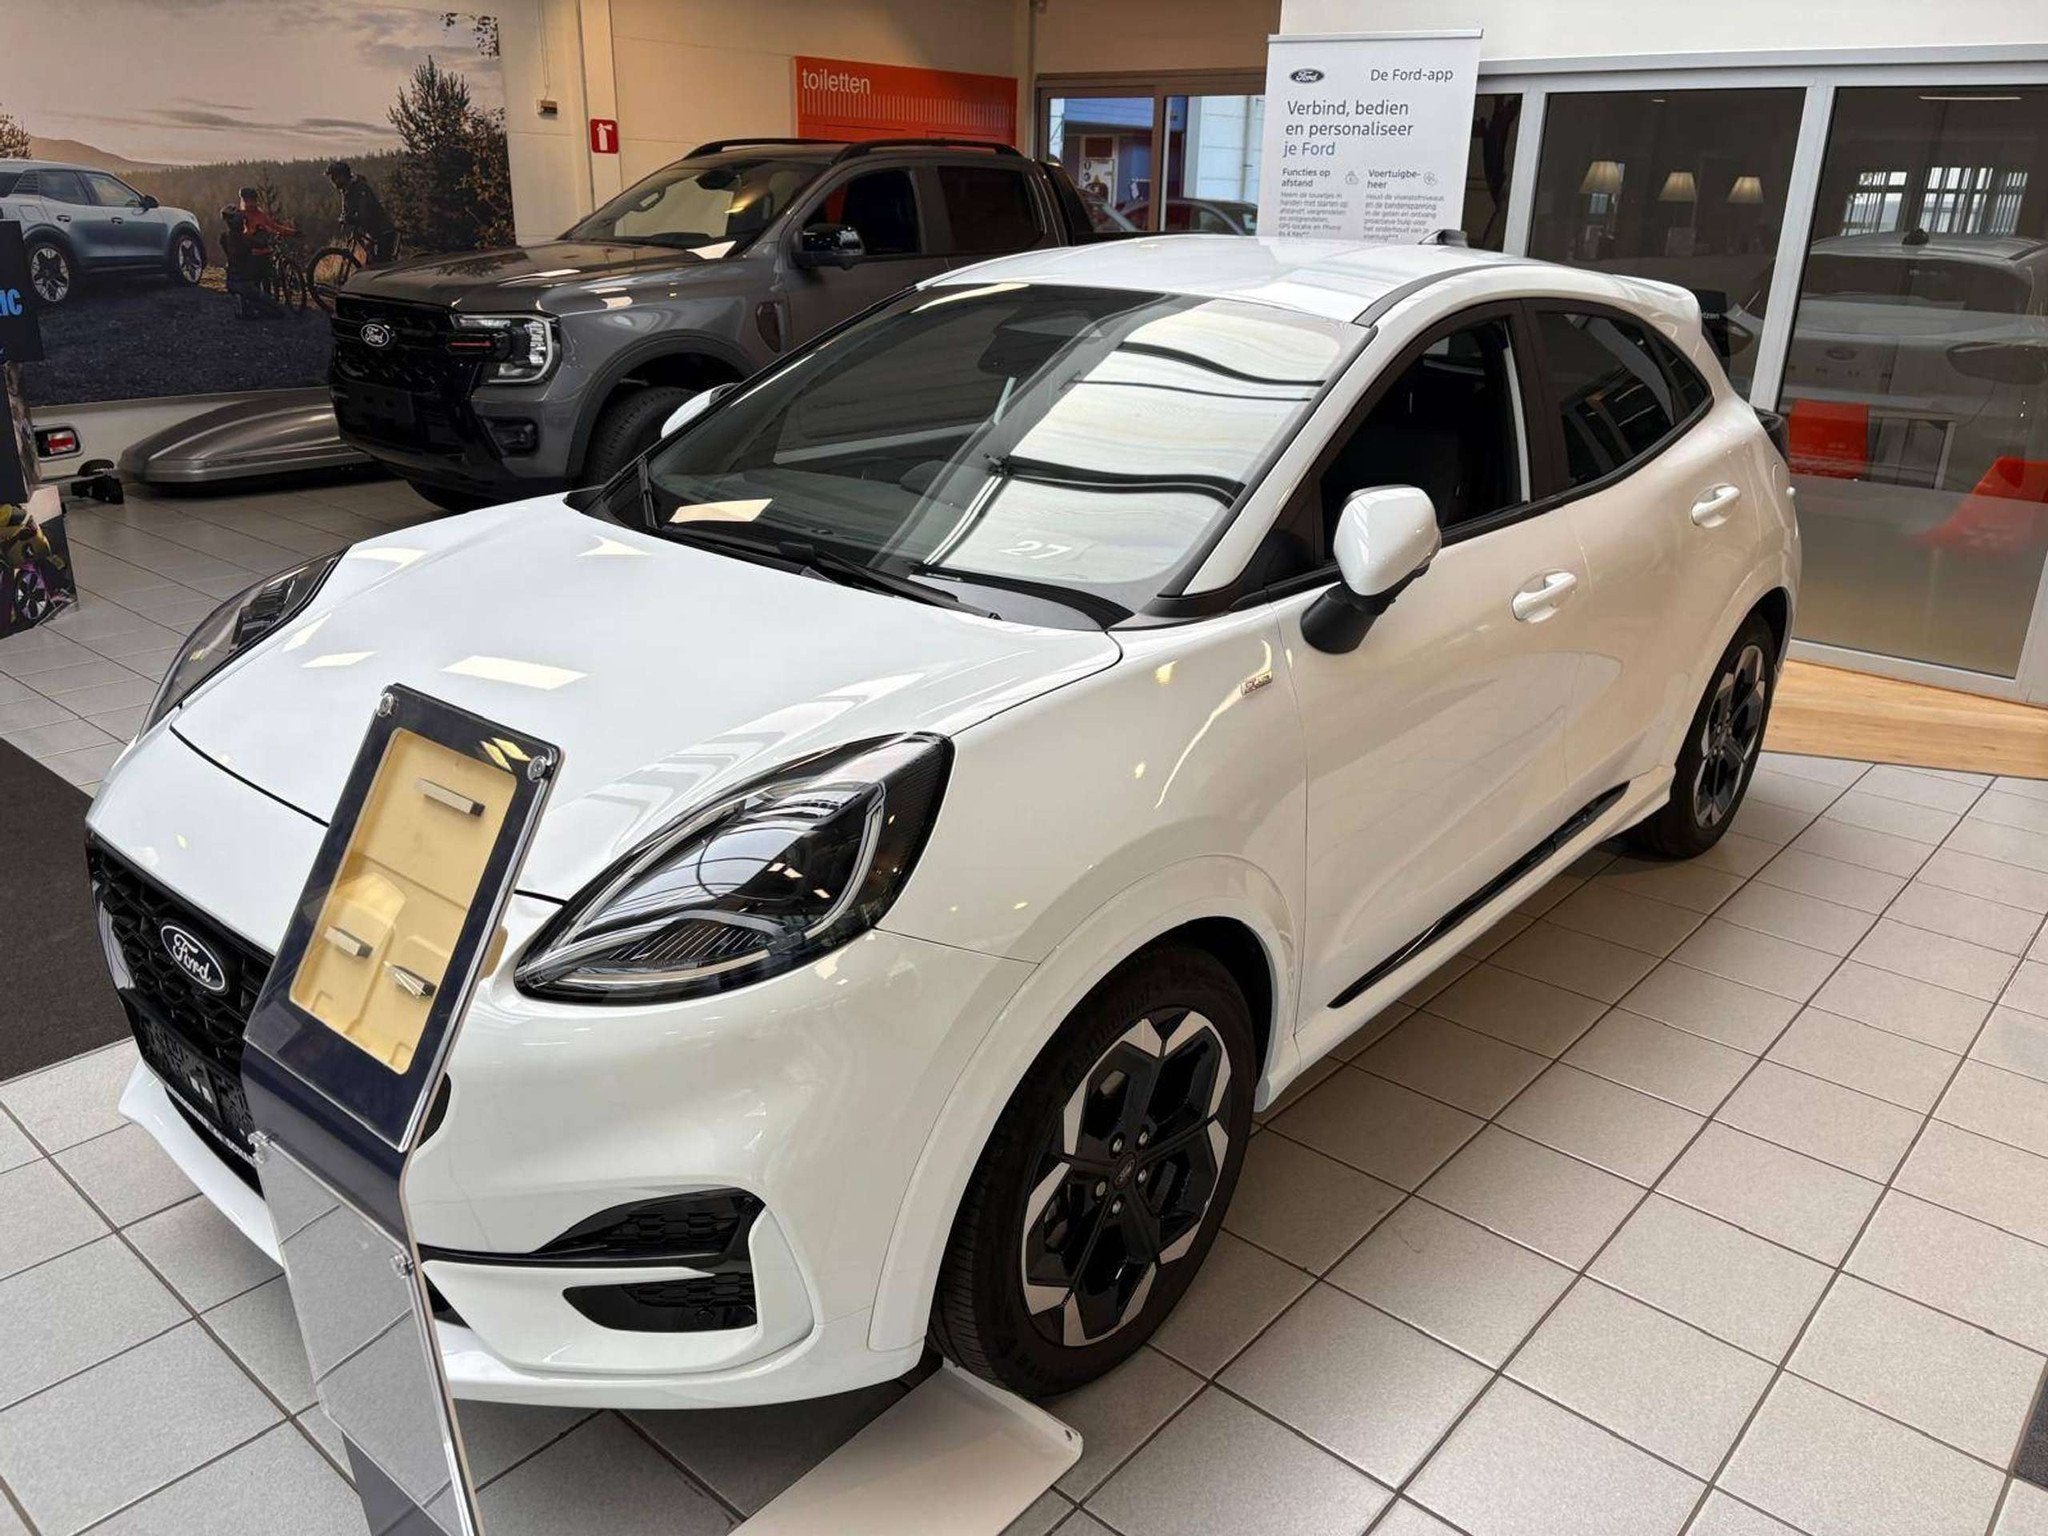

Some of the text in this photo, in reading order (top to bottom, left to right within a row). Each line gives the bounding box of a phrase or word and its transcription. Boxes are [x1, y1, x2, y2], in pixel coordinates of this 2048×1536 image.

[803, 67, 870, 95] toiletten
[1370, 68, 1454, 83] De Ford-app
[1287, 99, 1409, 117] Verbind, bedien
[1285, 121, 1414, 138] en personaliseer
[1283, 141, 1336, 158] je Ford
[1282, 167, 1331, 179] Functies op
[1368, 169, 1421, 180] Voertuigbe-
[1281, 179, 1314, 188] afstand
[1366, 180, 1388, 189] heer
[364, 326, 386, 344] Ford
[171, 932, 213, 985] Ford
